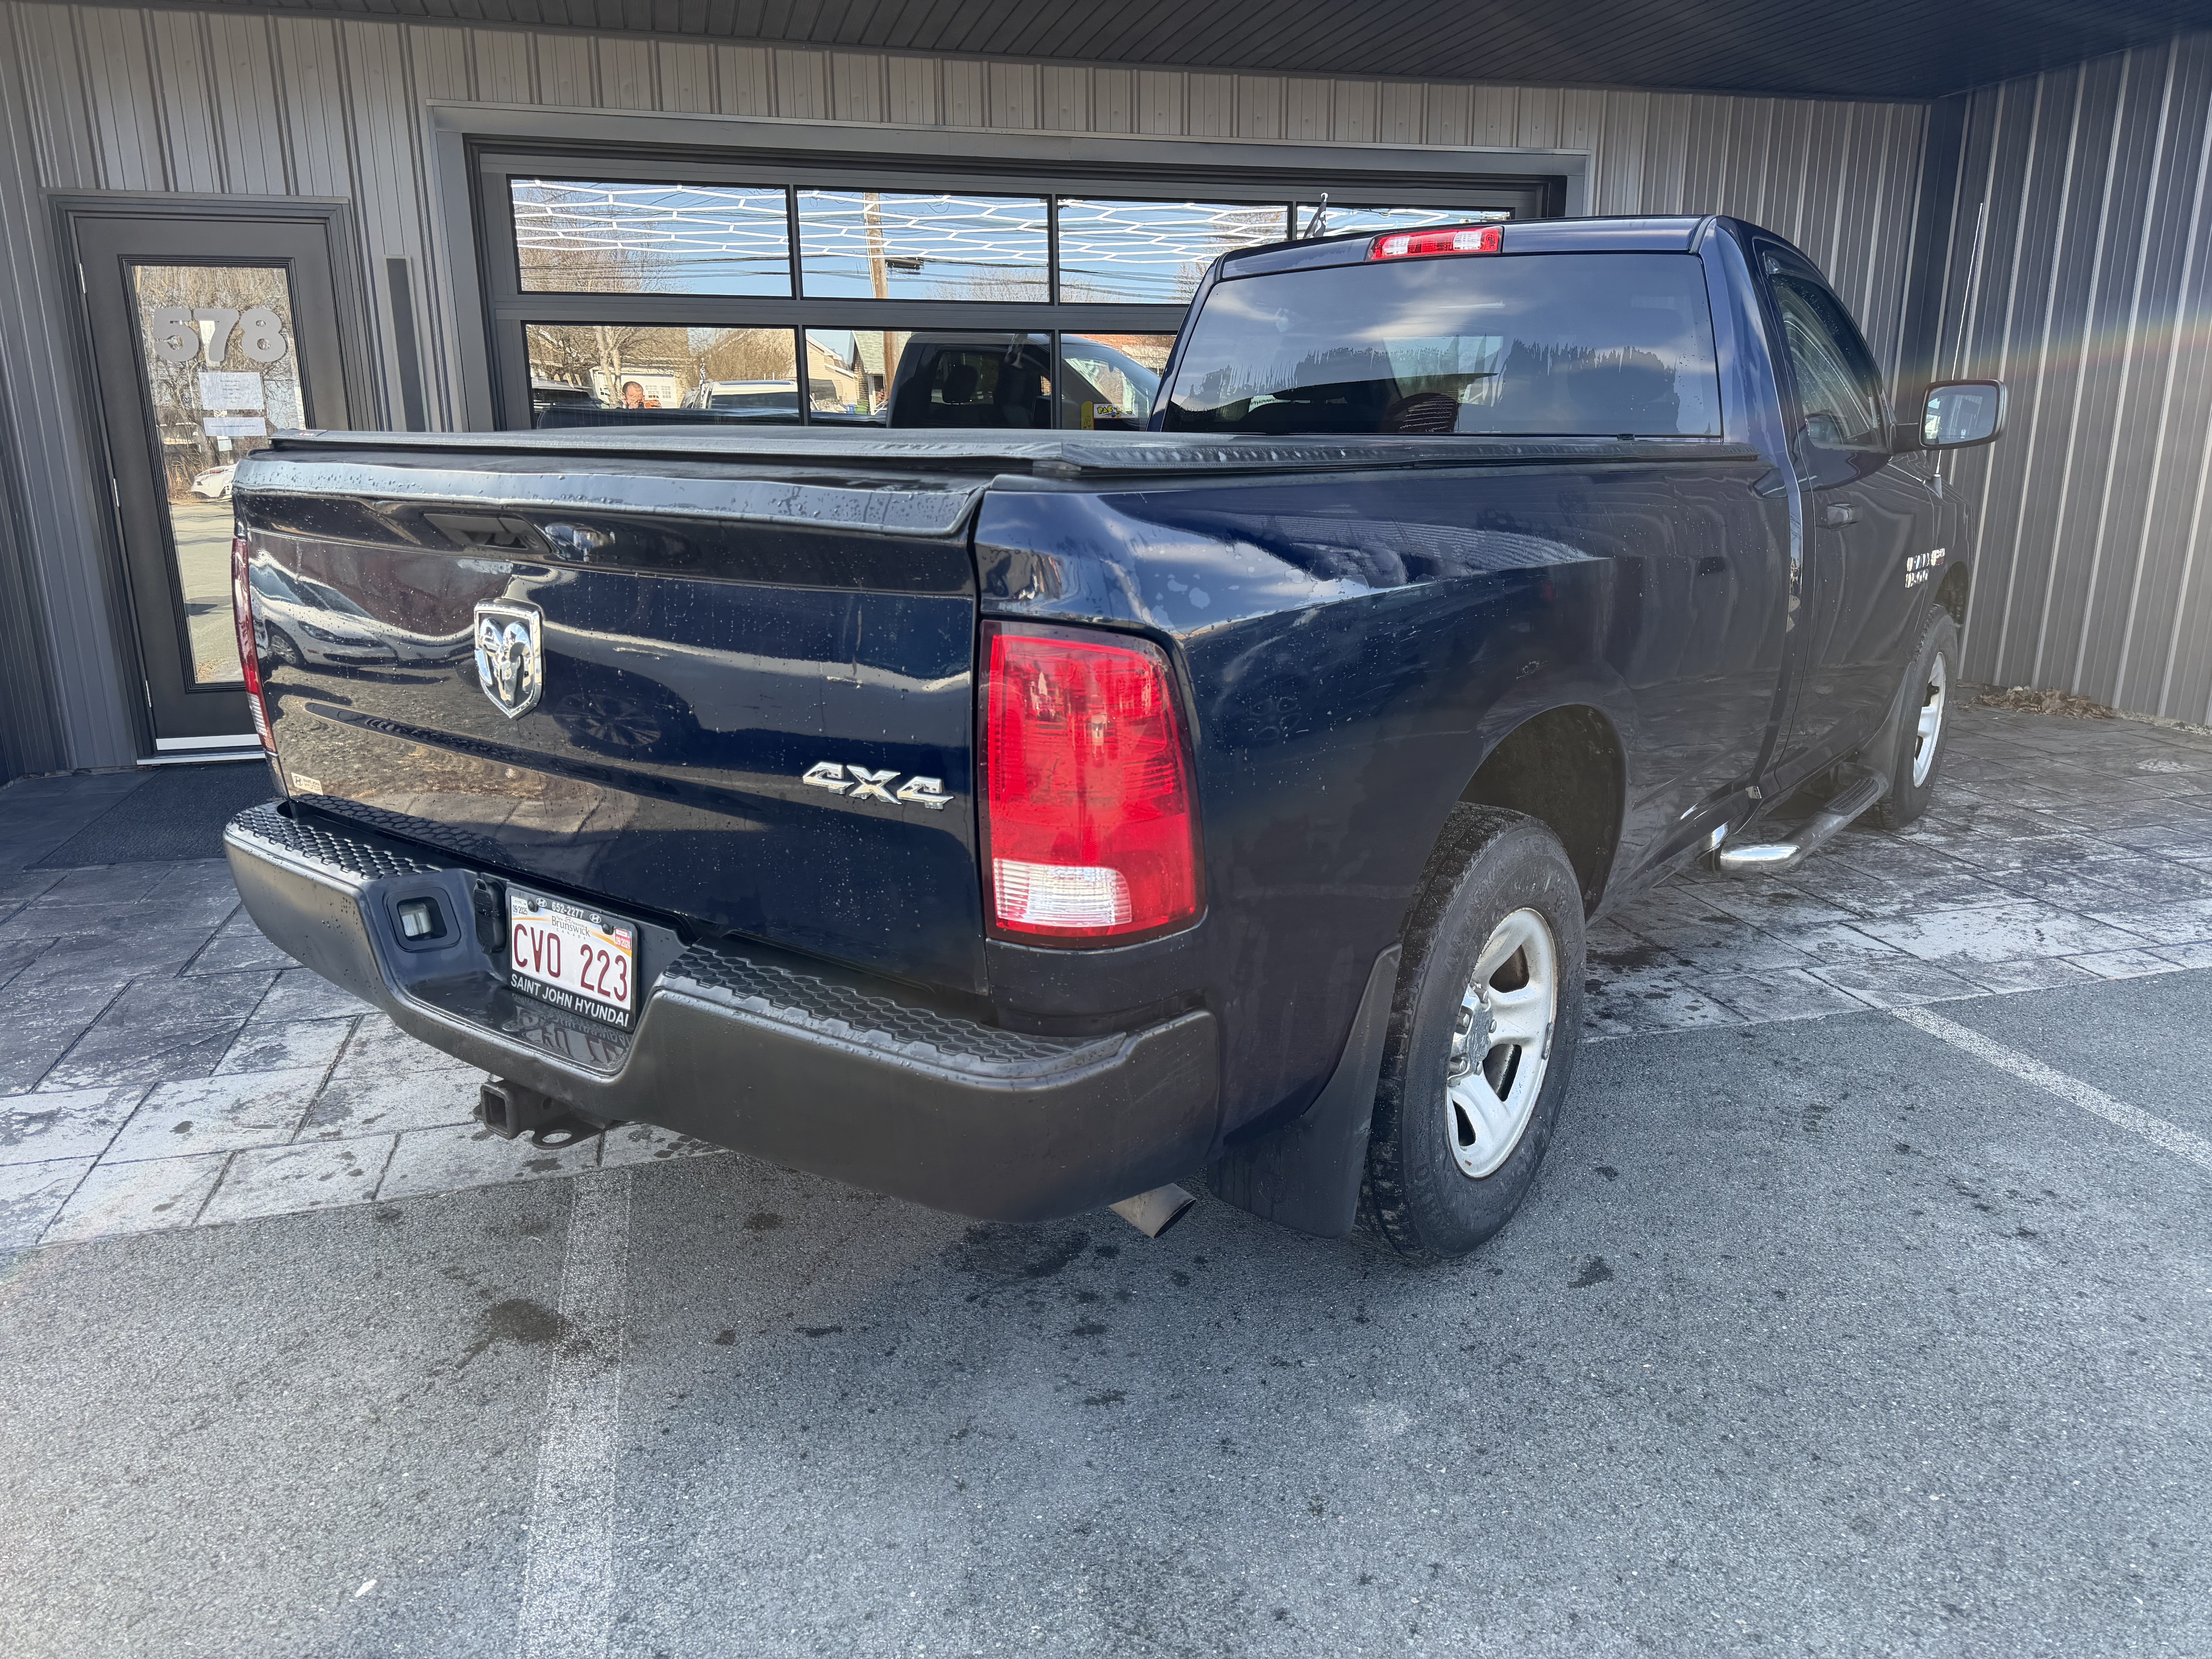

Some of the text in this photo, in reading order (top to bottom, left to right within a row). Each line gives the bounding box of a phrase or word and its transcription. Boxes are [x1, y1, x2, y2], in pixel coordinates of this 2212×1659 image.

[155, 308, 286, 362] 578
[552, 902, 584, 919] 652-2277
[552, 915, 591, 938] Brunswick
[556, 928, 586, 940] CANADA
[580, 944, 627, 1001] 223
[511, 974, 629, 1027] SAINT JOHN HYUNDAI
